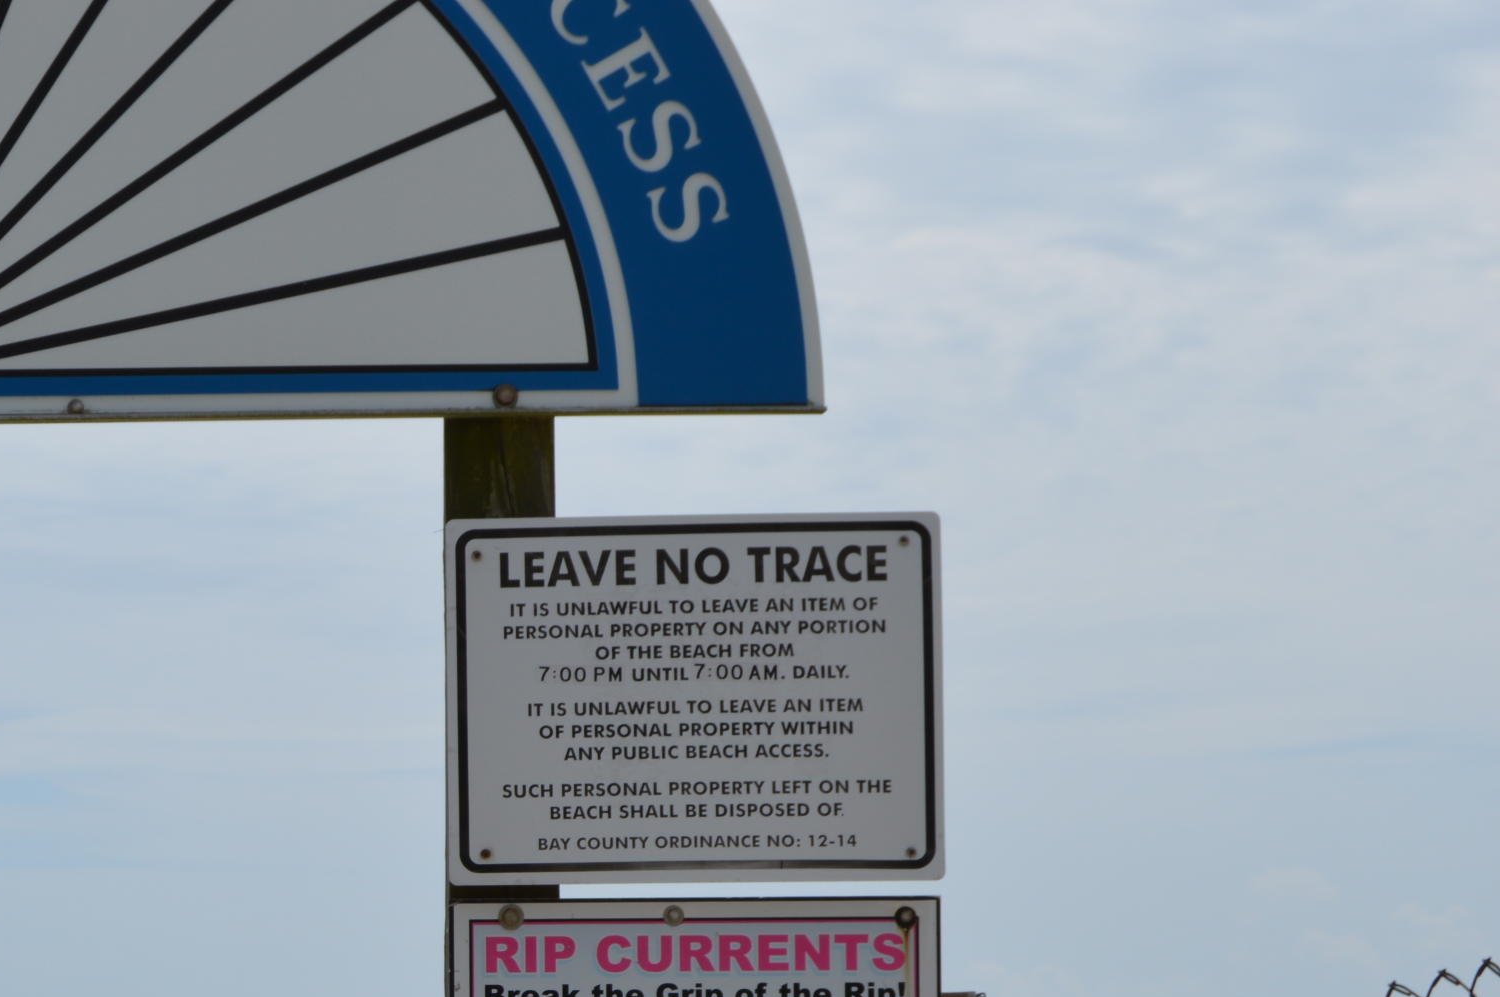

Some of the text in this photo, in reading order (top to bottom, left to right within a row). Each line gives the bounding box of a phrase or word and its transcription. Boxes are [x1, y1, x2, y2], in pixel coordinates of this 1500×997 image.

[550, 0, 730, 243] CESS
[499, 544, 887, 588] LEAVE NO TRACE
[510, 596, 877, 617] IT IS UNLAWFUL TO LEAVE AN ITEM OF
[503, 619, 885, 639] PERSONAL PROPERTY ON ANY PORTION
[539, 666, 586, 682] 7:00
[593, 666, 622, 682] PM
[631, 667, 688, 682] UNTIL
[694, 663, 743, 680] 7:00
[792, 664, 848, 679] DAILY.
[538, 834, 856, 850] BAY COUNTY ORDINANCE NO: 12-14
[485, 932, 906, 973] RIP CURRENTS
